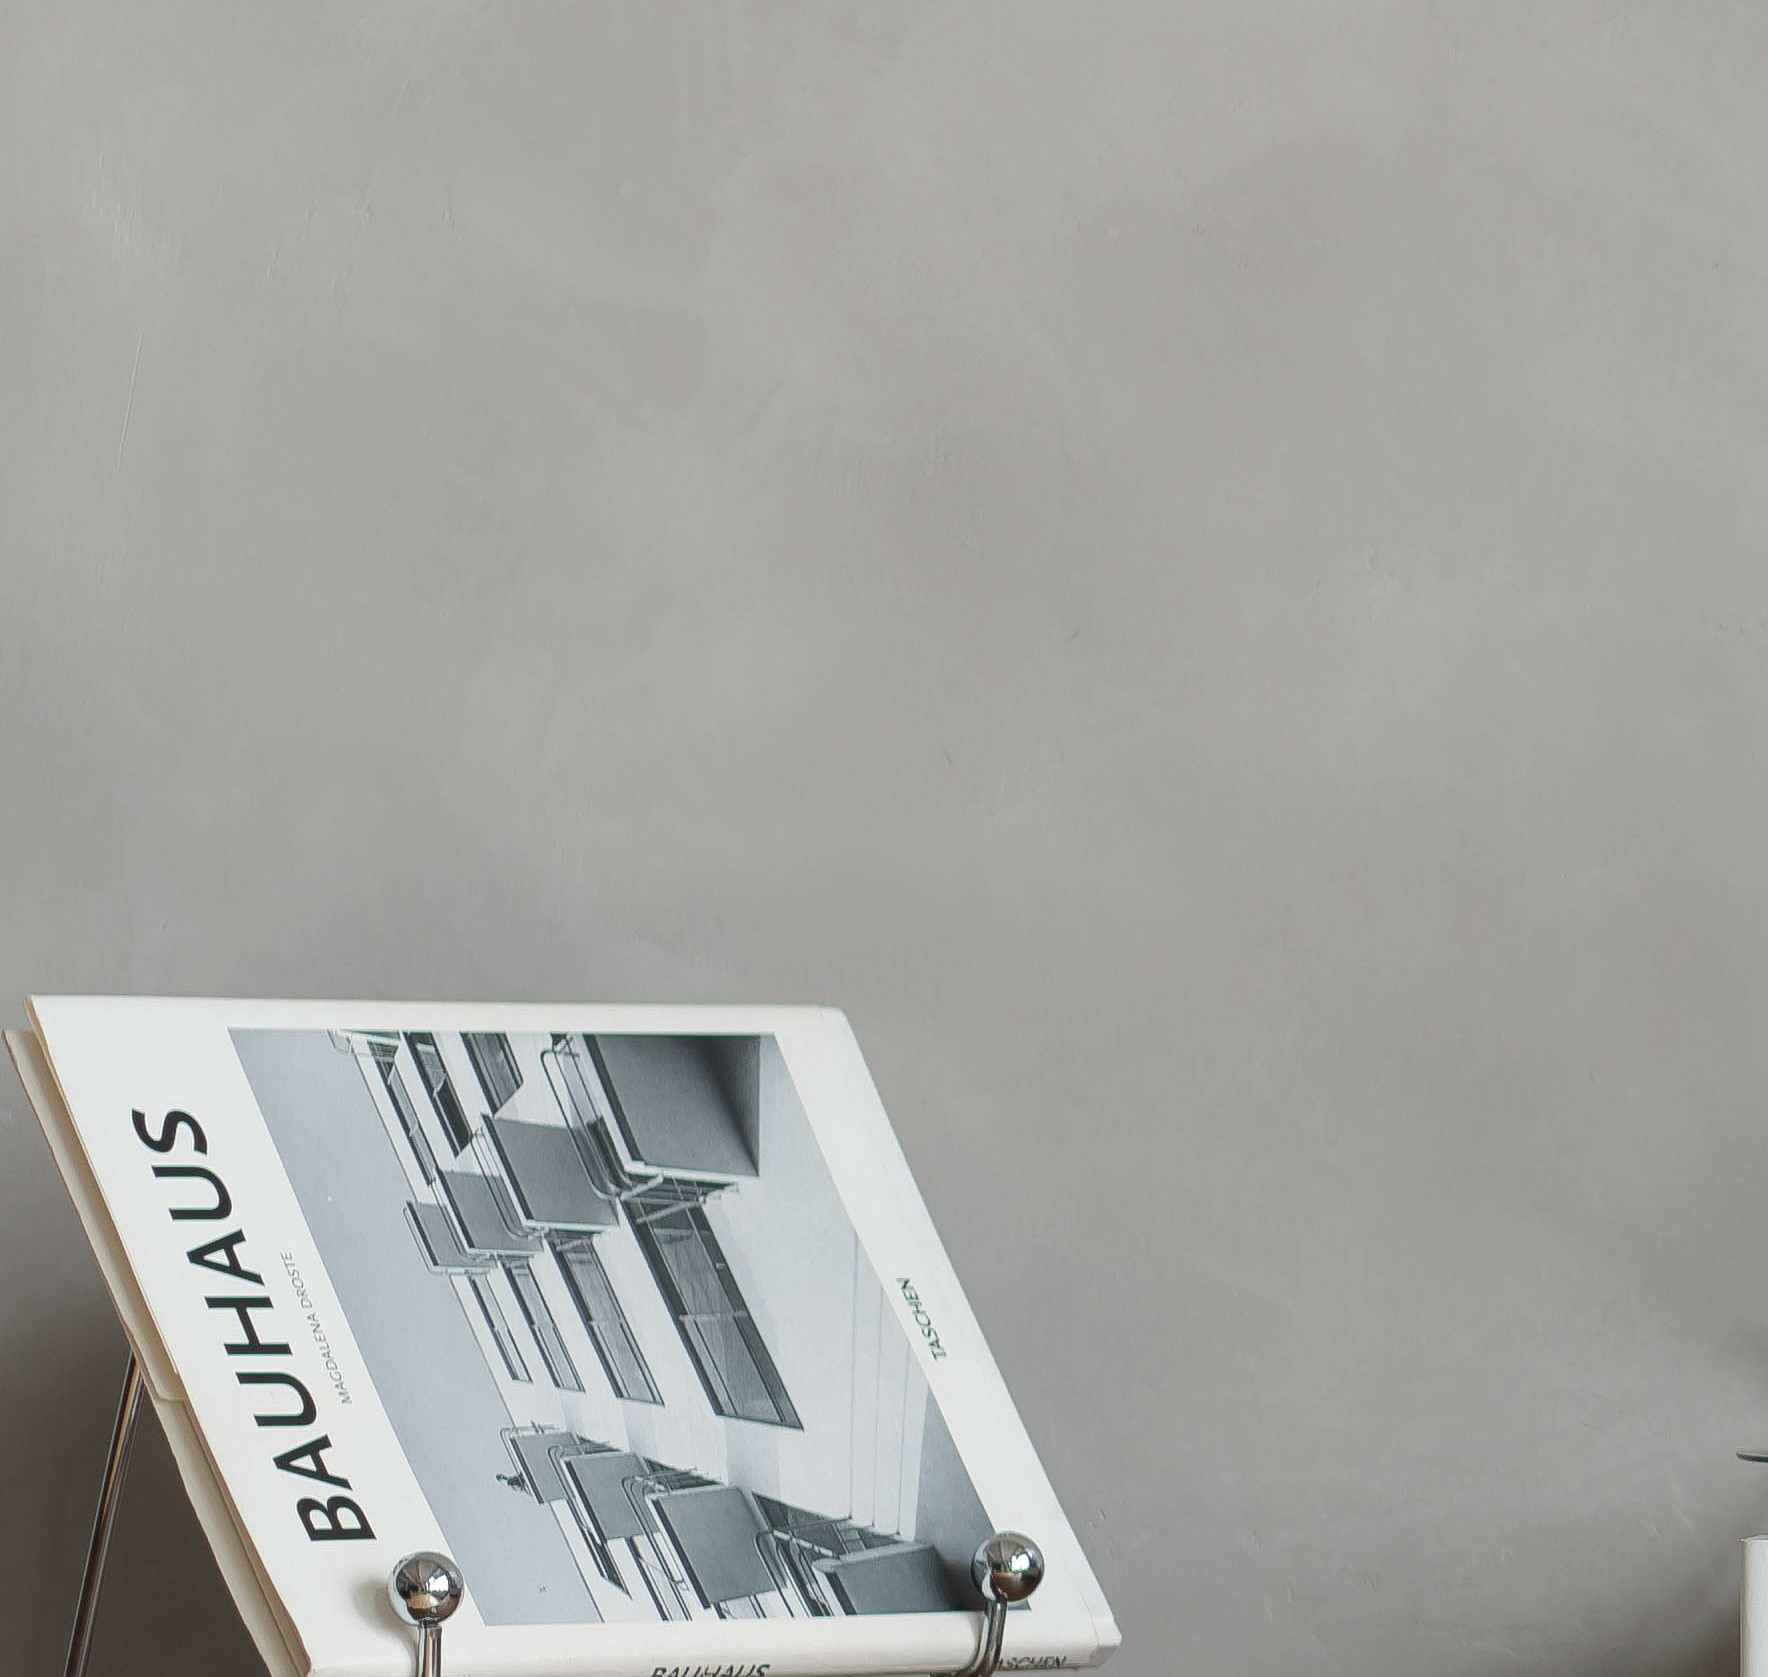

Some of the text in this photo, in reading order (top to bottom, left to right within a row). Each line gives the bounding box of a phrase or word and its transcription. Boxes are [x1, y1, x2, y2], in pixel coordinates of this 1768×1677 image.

[132, 1108, 377, 1541] BAUHAUS
[280, 1252, 352, 1404] MAGDALENA DROSTE
[896, 1278, 947, 1360] TASCHEN
